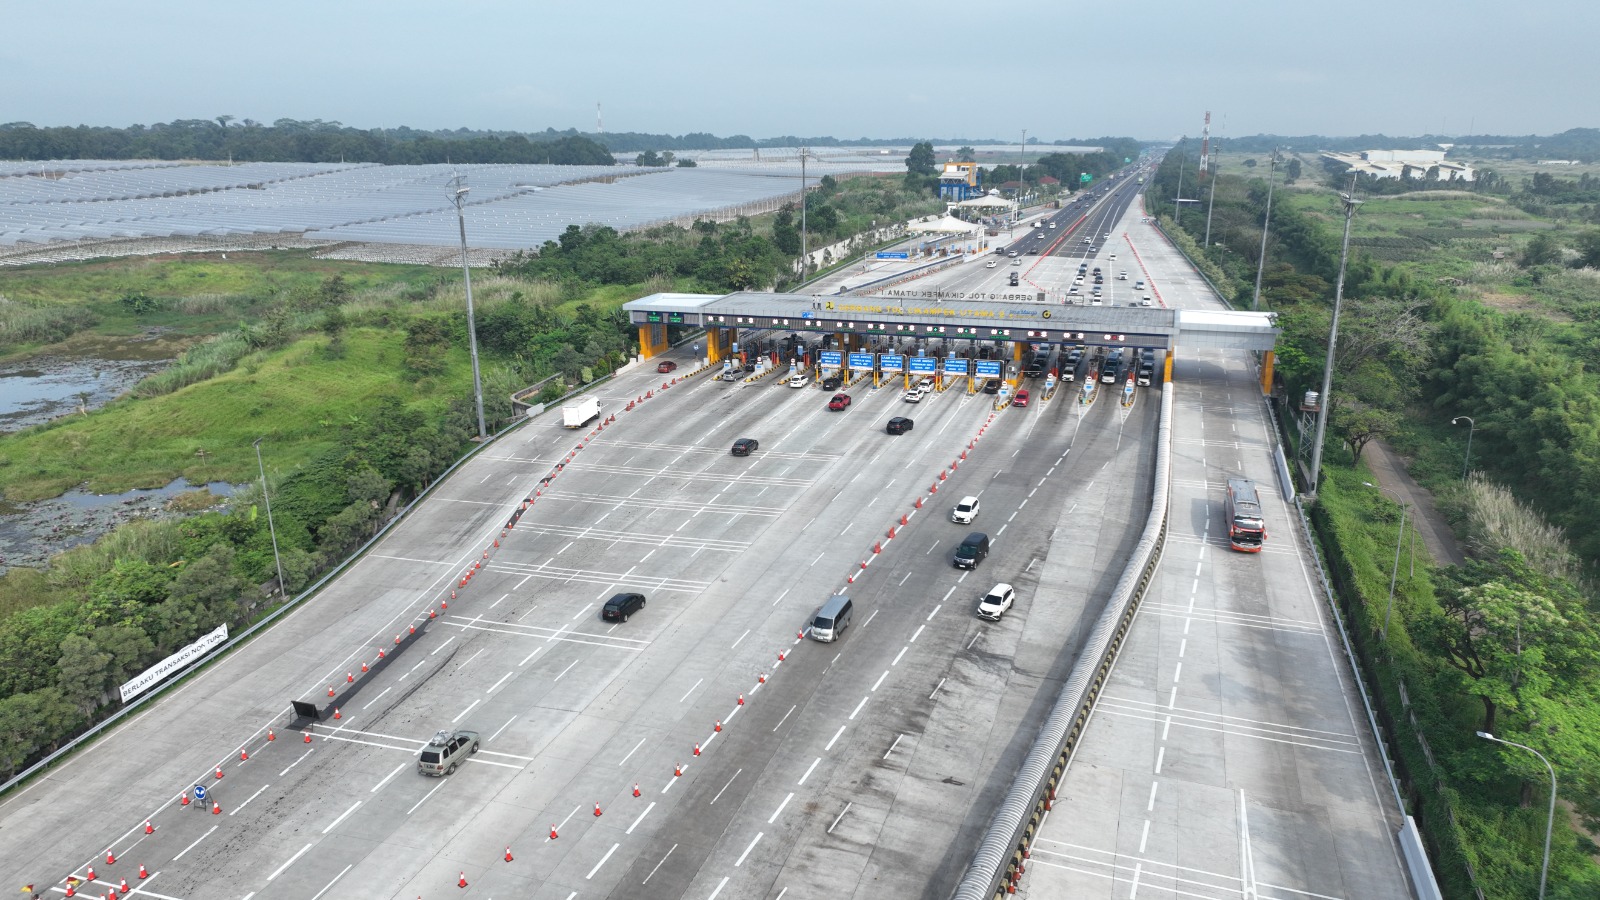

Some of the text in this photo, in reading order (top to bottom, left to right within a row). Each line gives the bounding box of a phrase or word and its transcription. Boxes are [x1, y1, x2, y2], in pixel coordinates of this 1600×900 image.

[959, 309, 994, 318] UTAMA
[123, 674, 154, 697] BERLAKU
[155, 652, 191, 676] TRANSAKSI
